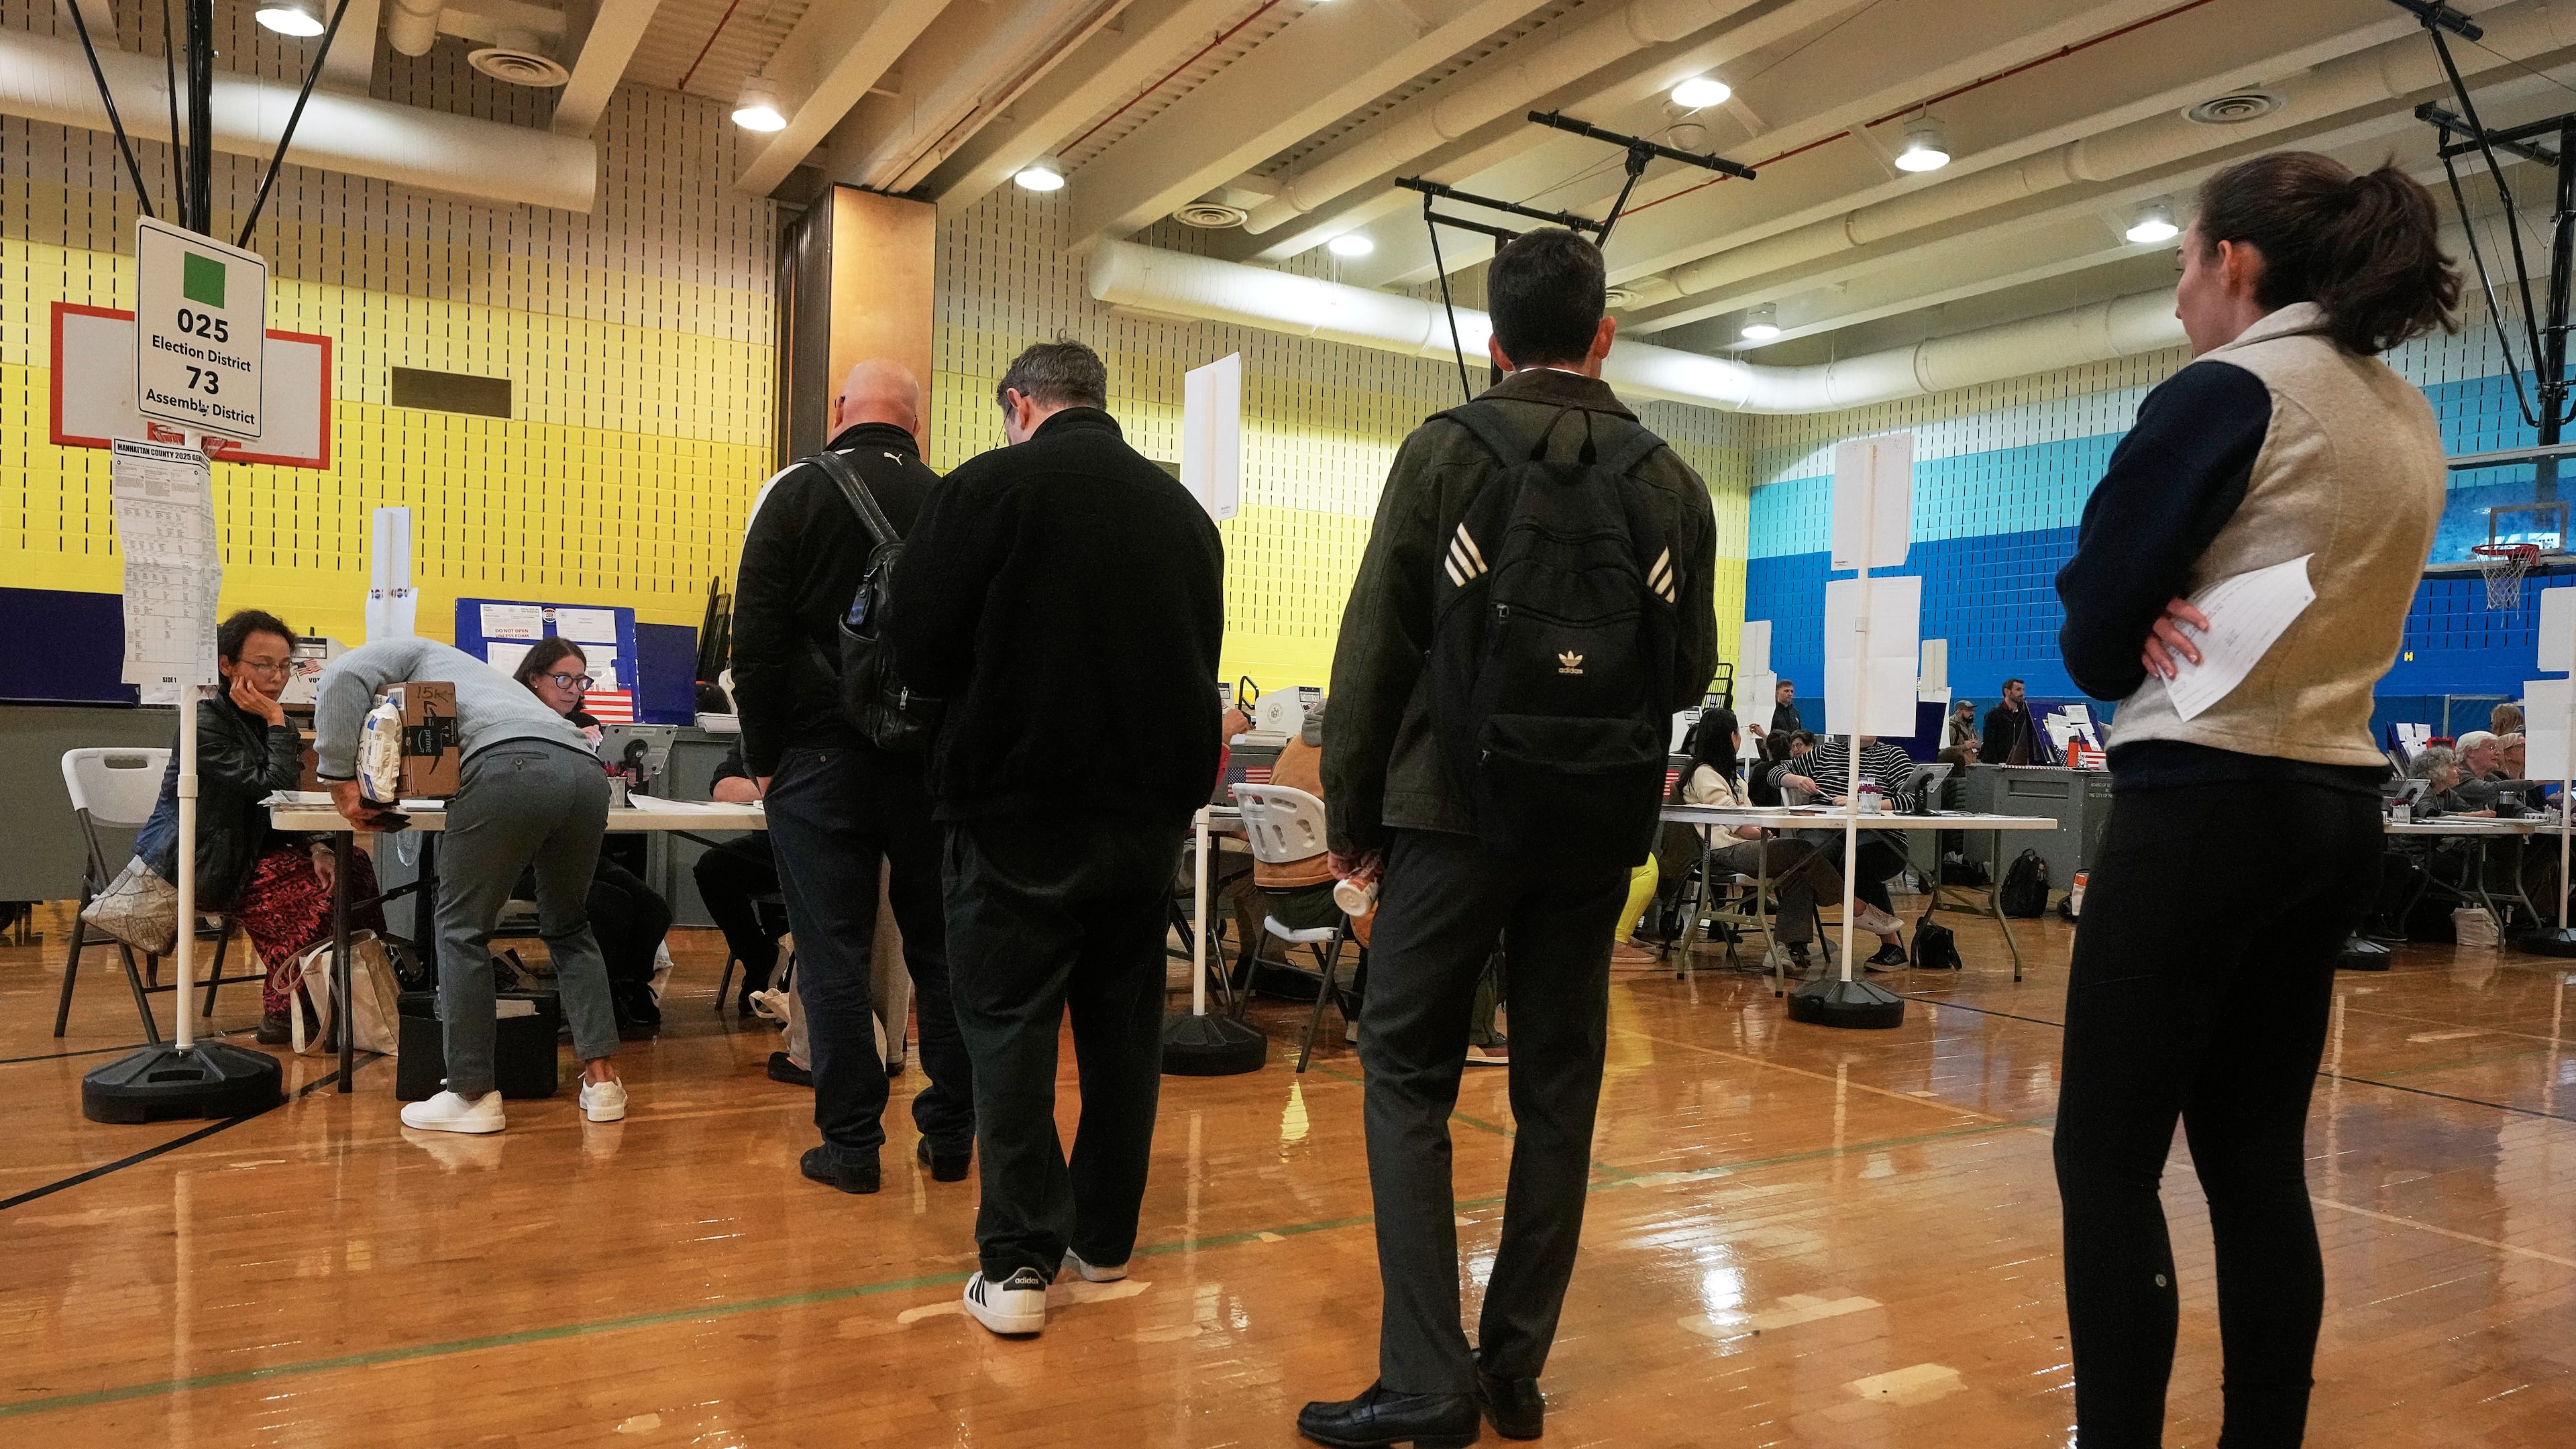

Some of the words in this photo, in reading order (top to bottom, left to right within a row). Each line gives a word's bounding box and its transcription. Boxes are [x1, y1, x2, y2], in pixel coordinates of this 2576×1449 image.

[177, 309, 229, 343] 025
[152, 334, 204, 360] Election
[208, 350, 251, 372] District
[186, 366, 219, 394] 73
[213, 404, 255, 425] District
[117, 443, 150, 455] MANHATTAN
[151, 449, 174, 458] COUNTY
[175, 452, 191, 461] 2025
[424, 729, 432, 753] prime
